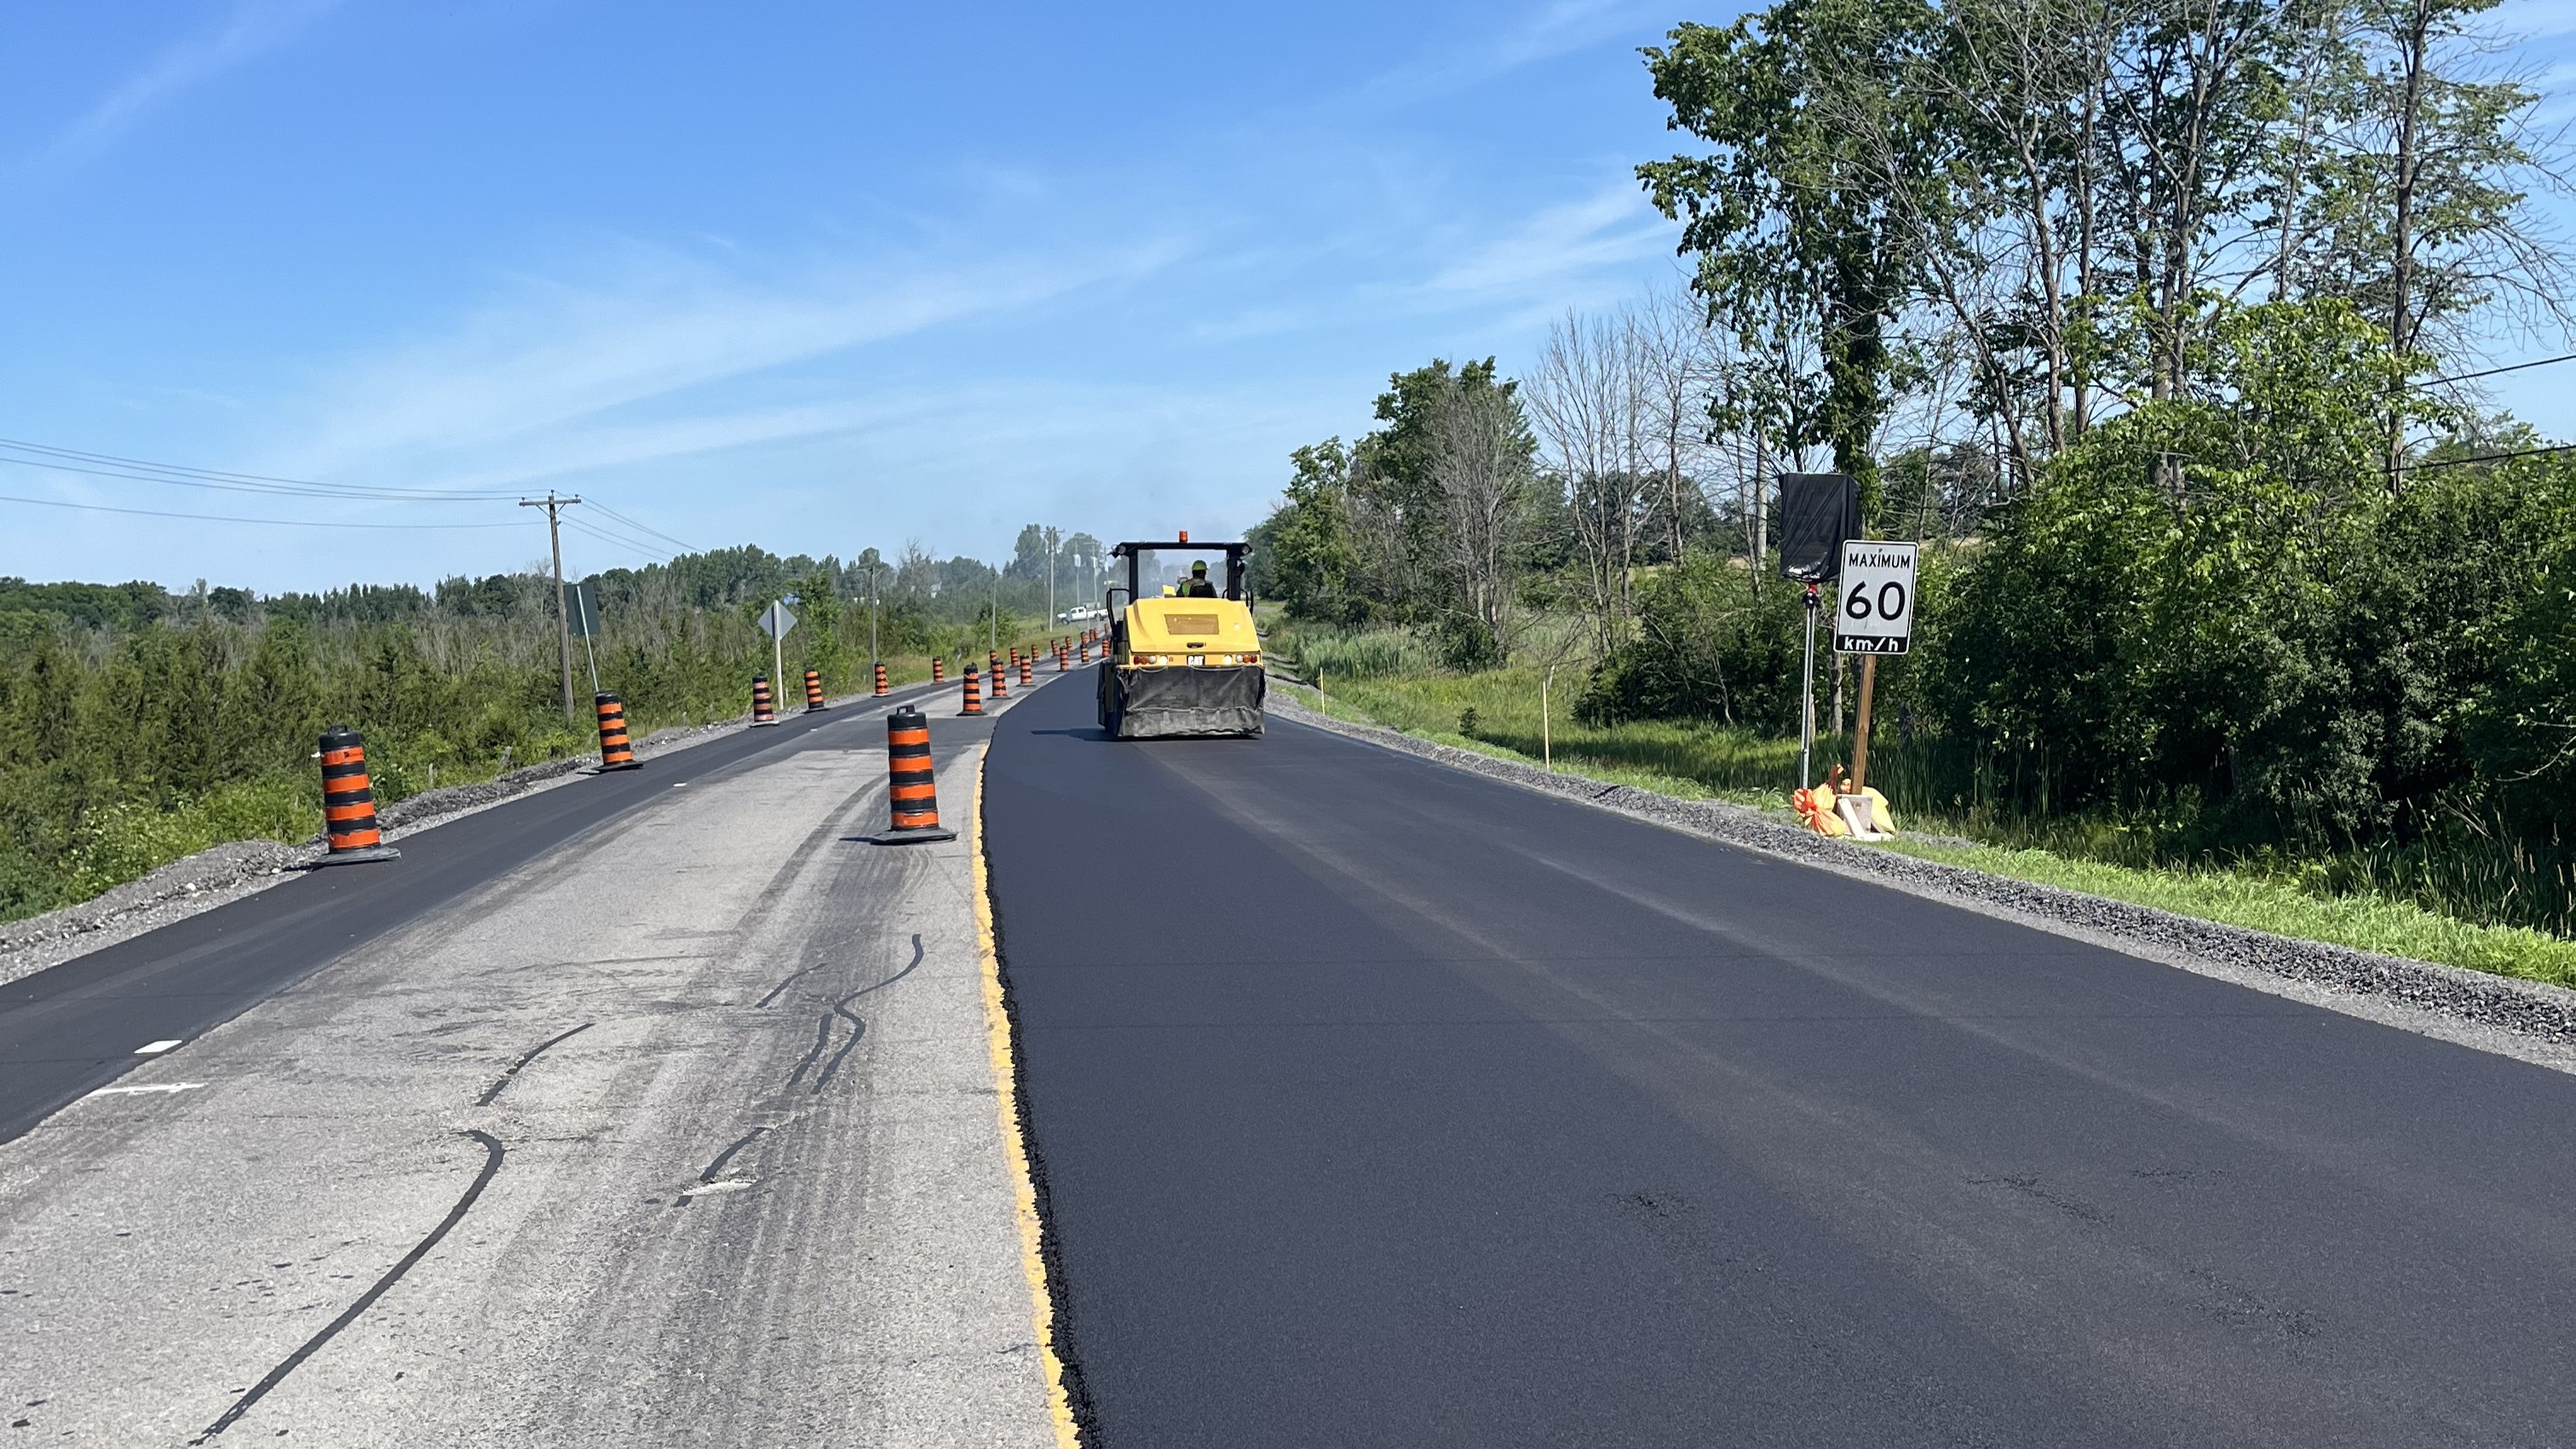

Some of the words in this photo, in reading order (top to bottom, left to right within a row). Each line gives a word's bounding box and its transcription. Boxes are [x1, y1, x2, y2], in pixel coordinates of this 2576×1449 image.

[1849, 553, 1911, 569] MAXIMUM
[1845, 580, 1906, 621] 60
[1843, 635, 1899, 652] km/h
[1187, 655, 1205, 666] CAT
